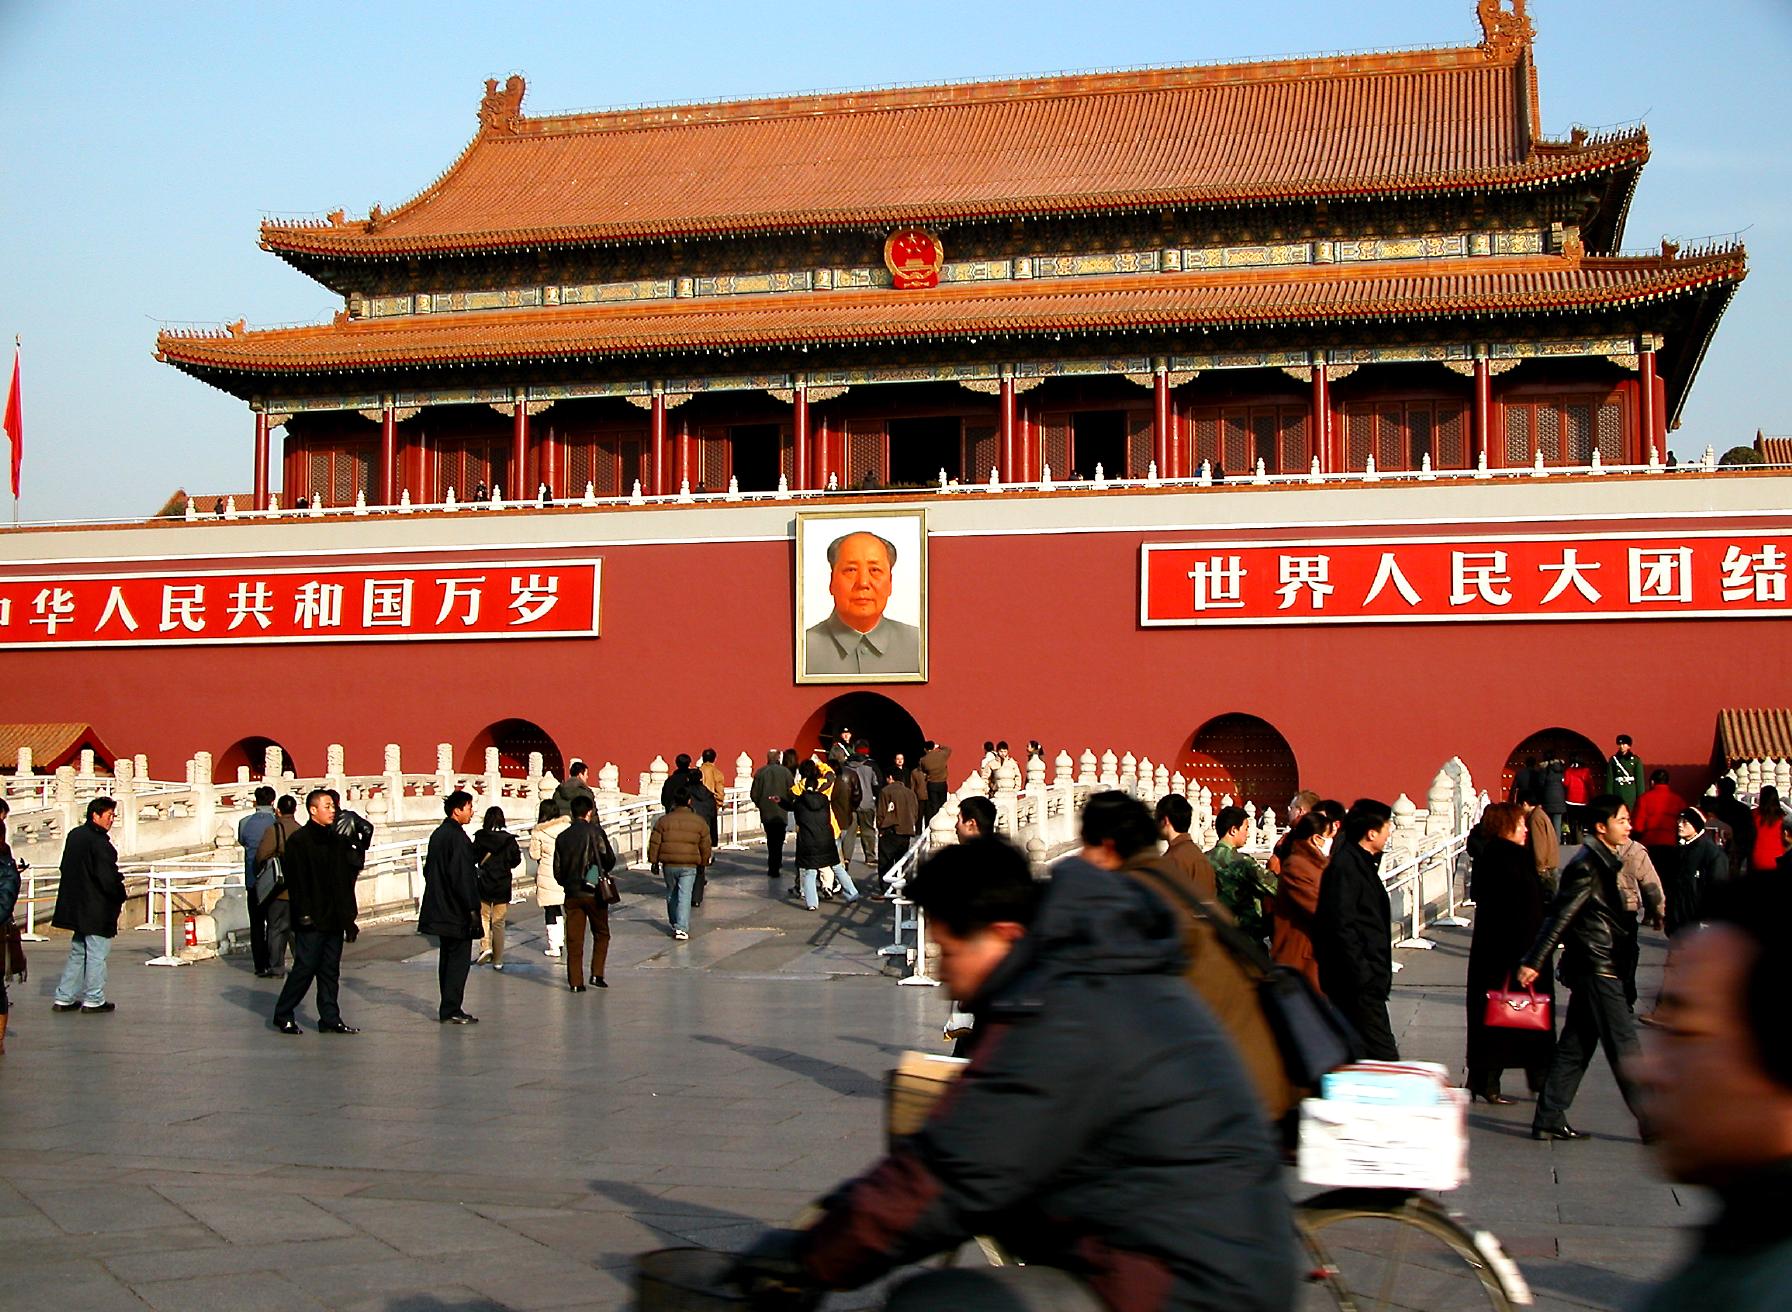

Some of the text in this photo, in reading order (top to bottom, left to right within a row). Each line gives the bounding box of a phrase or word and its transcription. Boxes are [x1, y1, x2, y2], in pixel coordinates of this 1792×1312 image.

[0, 574, 559, 635] 华人民共和国万岁
[1187, 545, 1788, 610] 世界人民大团结
